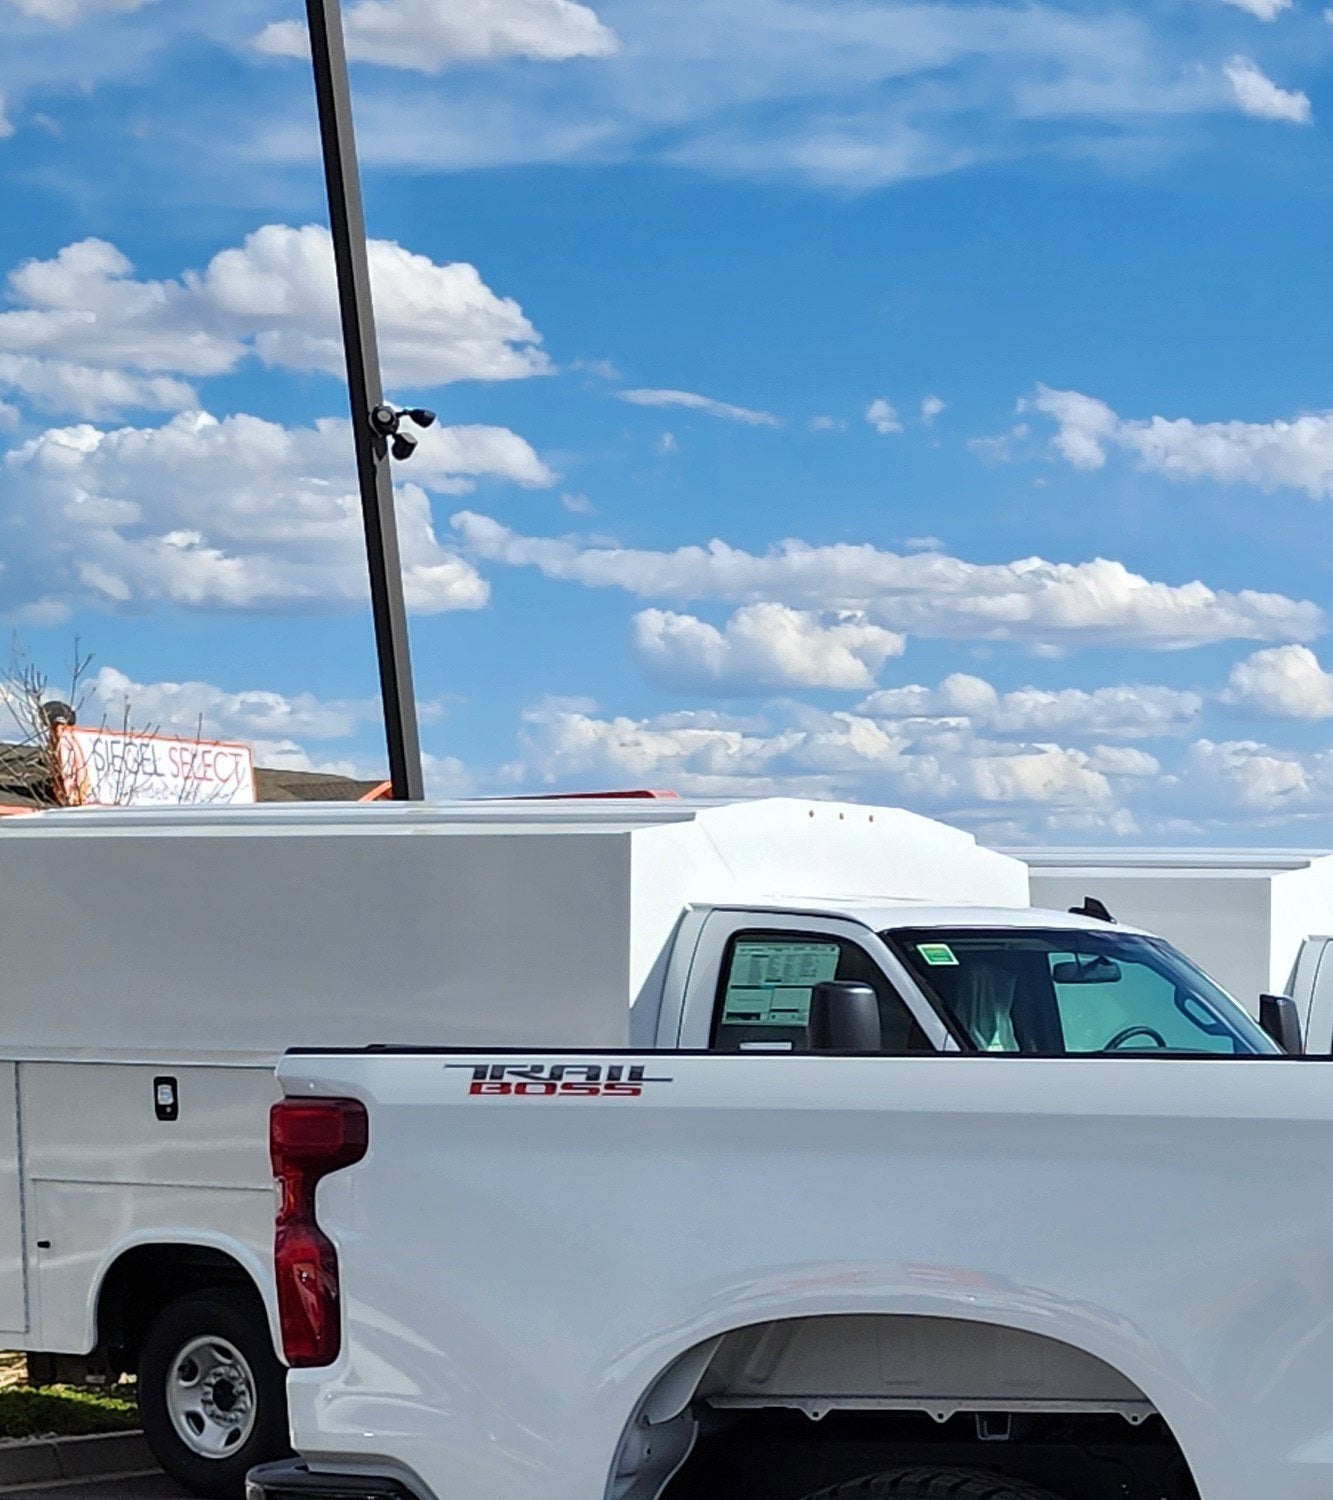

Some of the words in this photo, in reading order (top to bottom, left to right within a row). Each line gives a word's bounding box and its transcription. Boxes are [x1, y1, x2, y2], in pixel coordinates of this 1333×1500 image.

[93, 737, 165, 777] SIEGEL
[168, 746, 243, 785] SELECT
[444, 1064, 673, 1082] TRAIL
[468, 1082, 643, 1096] BOSS
